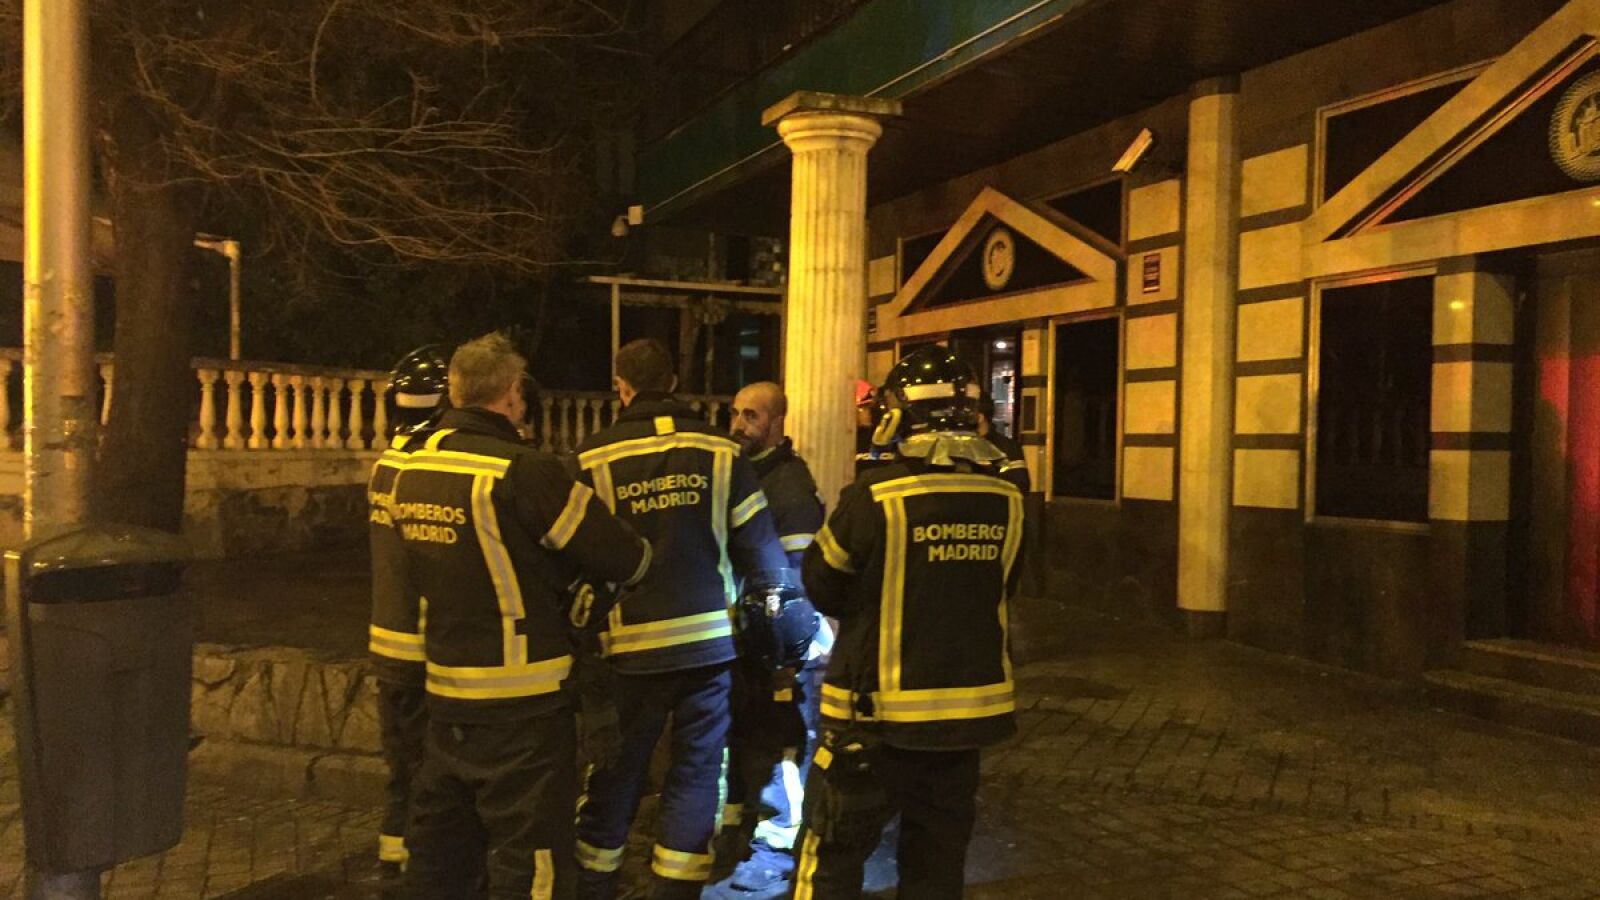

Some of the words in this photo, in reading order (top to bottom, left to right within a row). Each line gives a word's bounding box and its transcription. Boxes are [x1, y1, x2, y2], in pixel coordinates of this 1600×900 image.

[617, 473, 709, 500] BOMBEROS
[631, 491, 701, 514] MADRID
[402, 523, 458, 544] MADRID
[928, 544, 999, 562] MADRID
